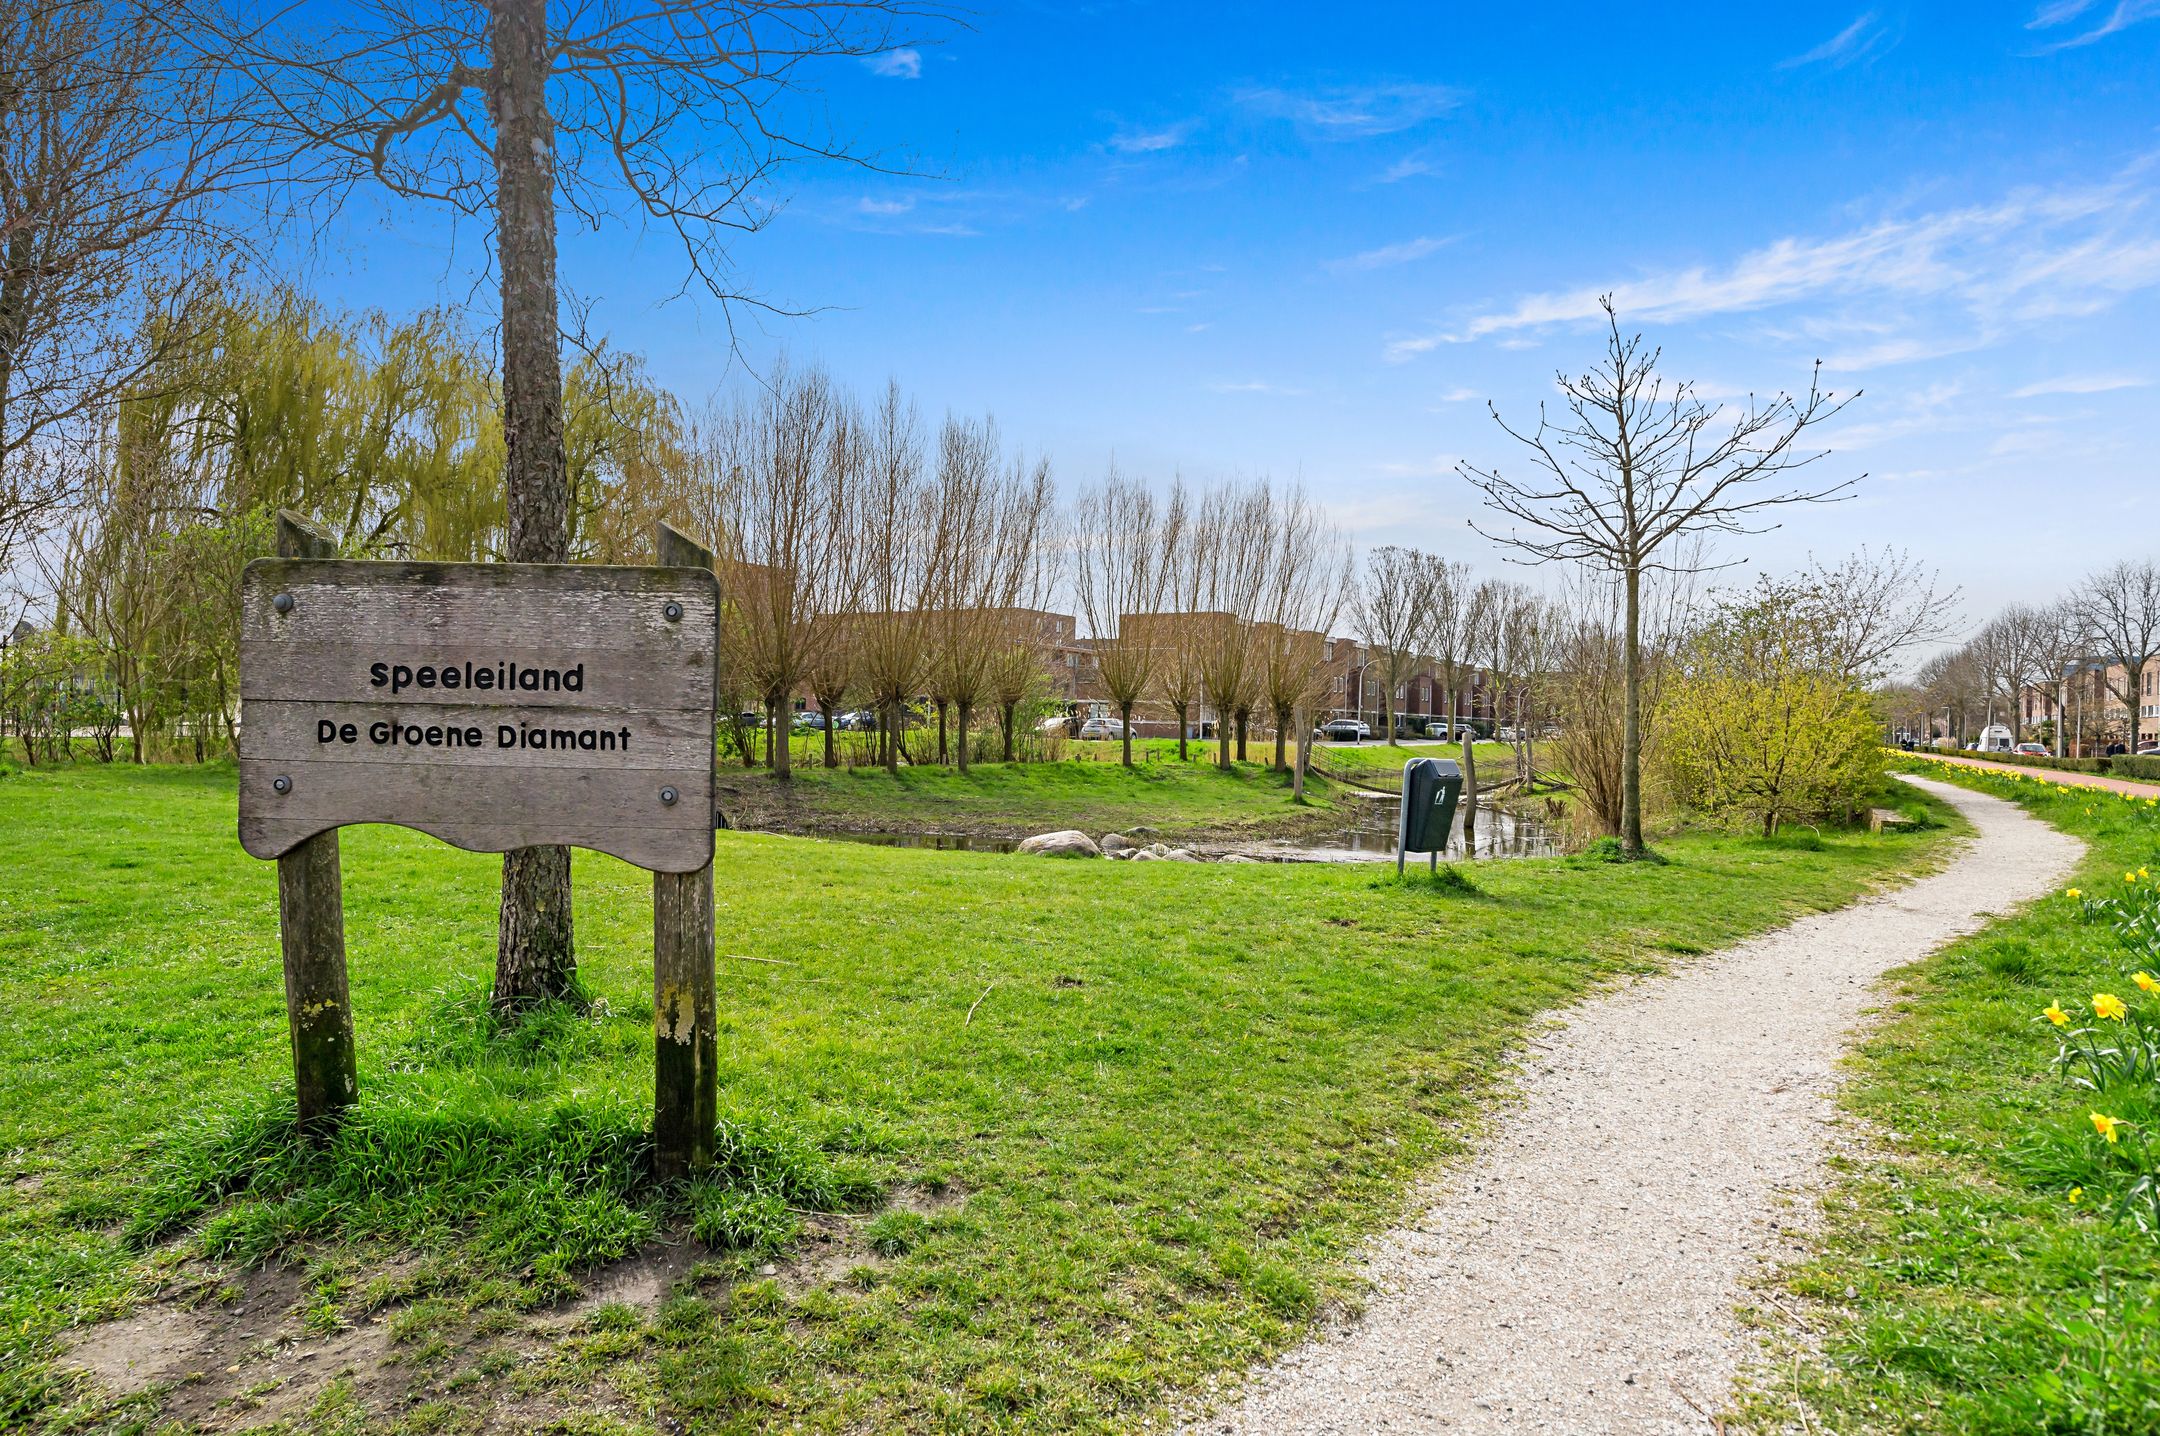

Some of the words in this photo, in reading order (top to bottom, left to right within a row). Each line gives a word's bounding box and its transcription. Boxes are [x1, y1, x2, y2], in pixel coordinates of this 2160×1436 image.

[370, 661, 584, 695] Speeleiland
[317, 719, 358, 745] De
[369, 721, 483, 748] Groene
[497, 721, 632, 752] Diamant
